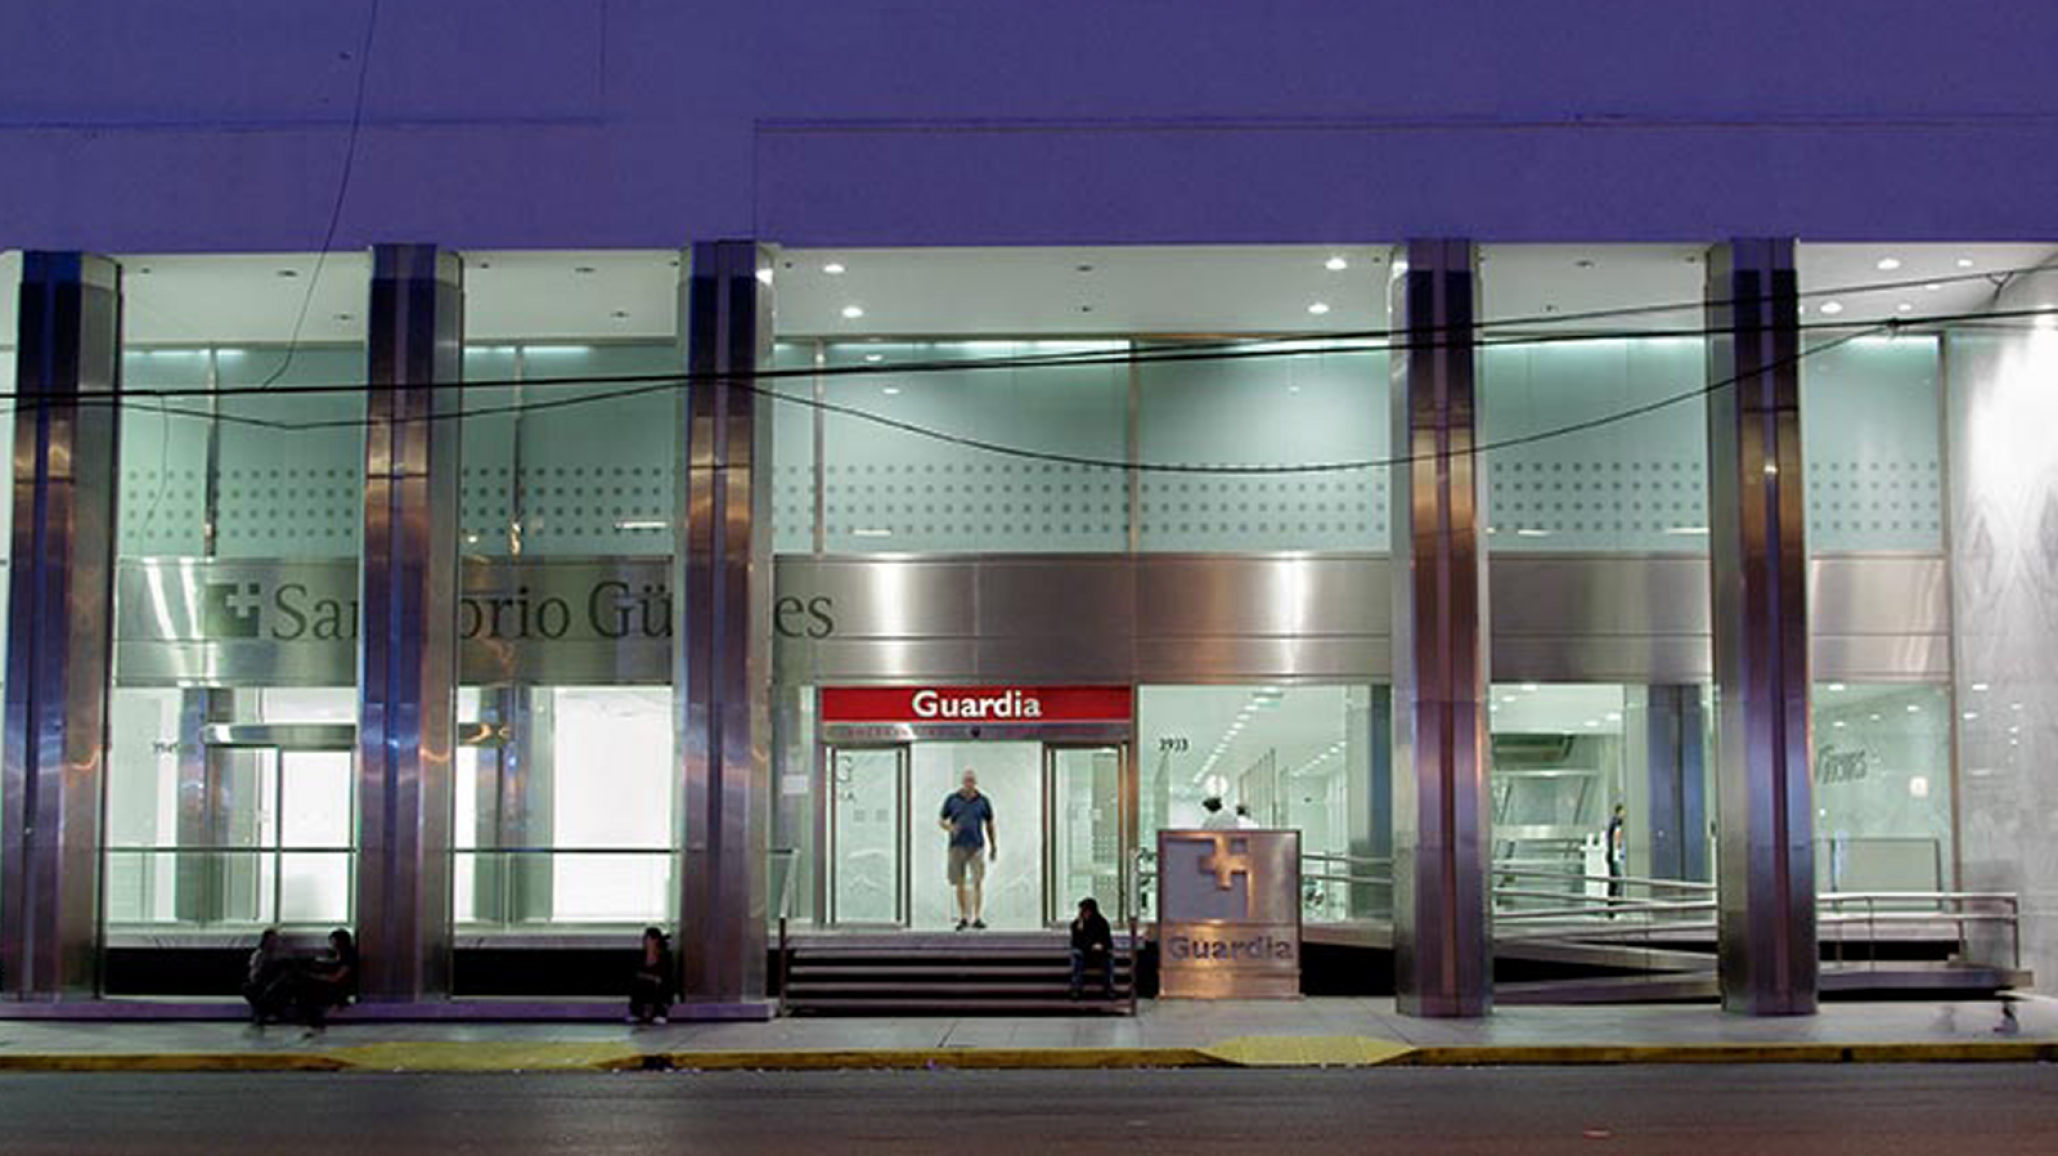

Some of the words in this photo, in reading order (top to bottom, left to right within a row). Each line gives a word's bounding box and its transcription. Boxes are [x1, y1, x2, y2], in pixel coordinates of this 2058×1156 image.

[271, 582, 571, 640] Saorio
[588, 580, 834, 640] Gües
[911, 689, 1042, 718] Guardia
[1167, 935, 1294, 960] Guardia
